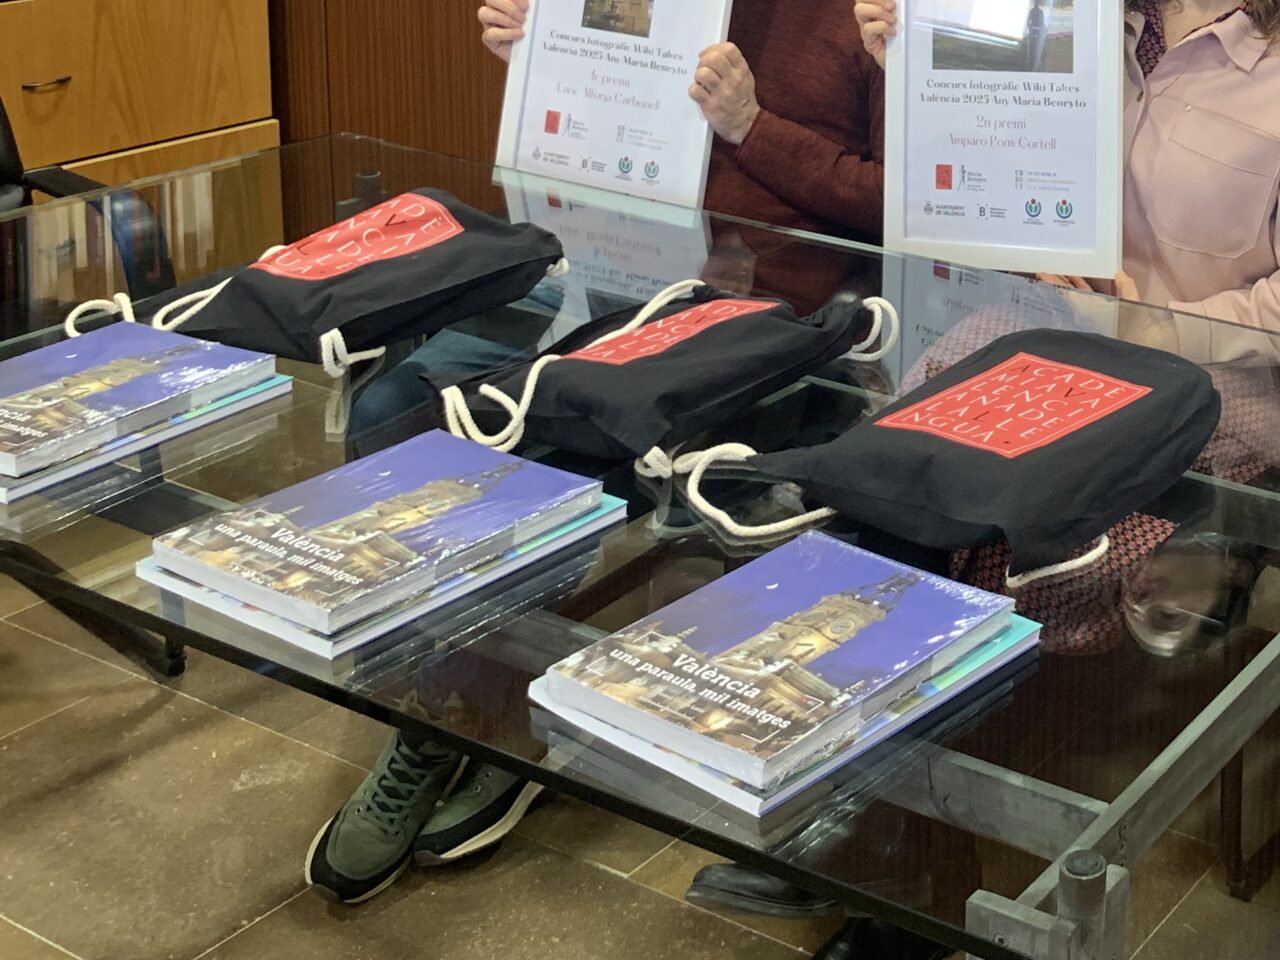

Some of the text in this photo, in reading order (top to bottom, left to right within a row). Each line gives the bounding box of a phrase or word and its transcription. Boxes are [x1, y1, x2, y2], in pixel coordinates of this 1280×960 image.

[550, 29, 585, 43] Concurs
[634, 43, 655, 56] Wiki
[657, 48, 684, 61] Takes
[580, 48, 603, 60] 2025
[623, 55, 648, 69] Maria
[650, 60, 688, 75] Beneyto
[601, 74, 631, 87] premi
[926, 78, 967, 89] Concurs
[1022, 82, 1046, 92] Wiki
[1049, 82, 1080, 93] Takes
[962, 94, 990, 104] 2025
[992, 95, 1009, 107] Any
[1012, 96, 1041, 107] Maria
[1043, 97, 1087, 109] Beneyto
[975, 114, 1027, 132] 2n premi
[949, 133, 1057, 150] Amparo Pons Cortell
[214, 523, 363, 585] una paraula, mil imatges
[671, 653, 761, 699] València
[609, 648, 792, 730] una paraula, mil imatges
